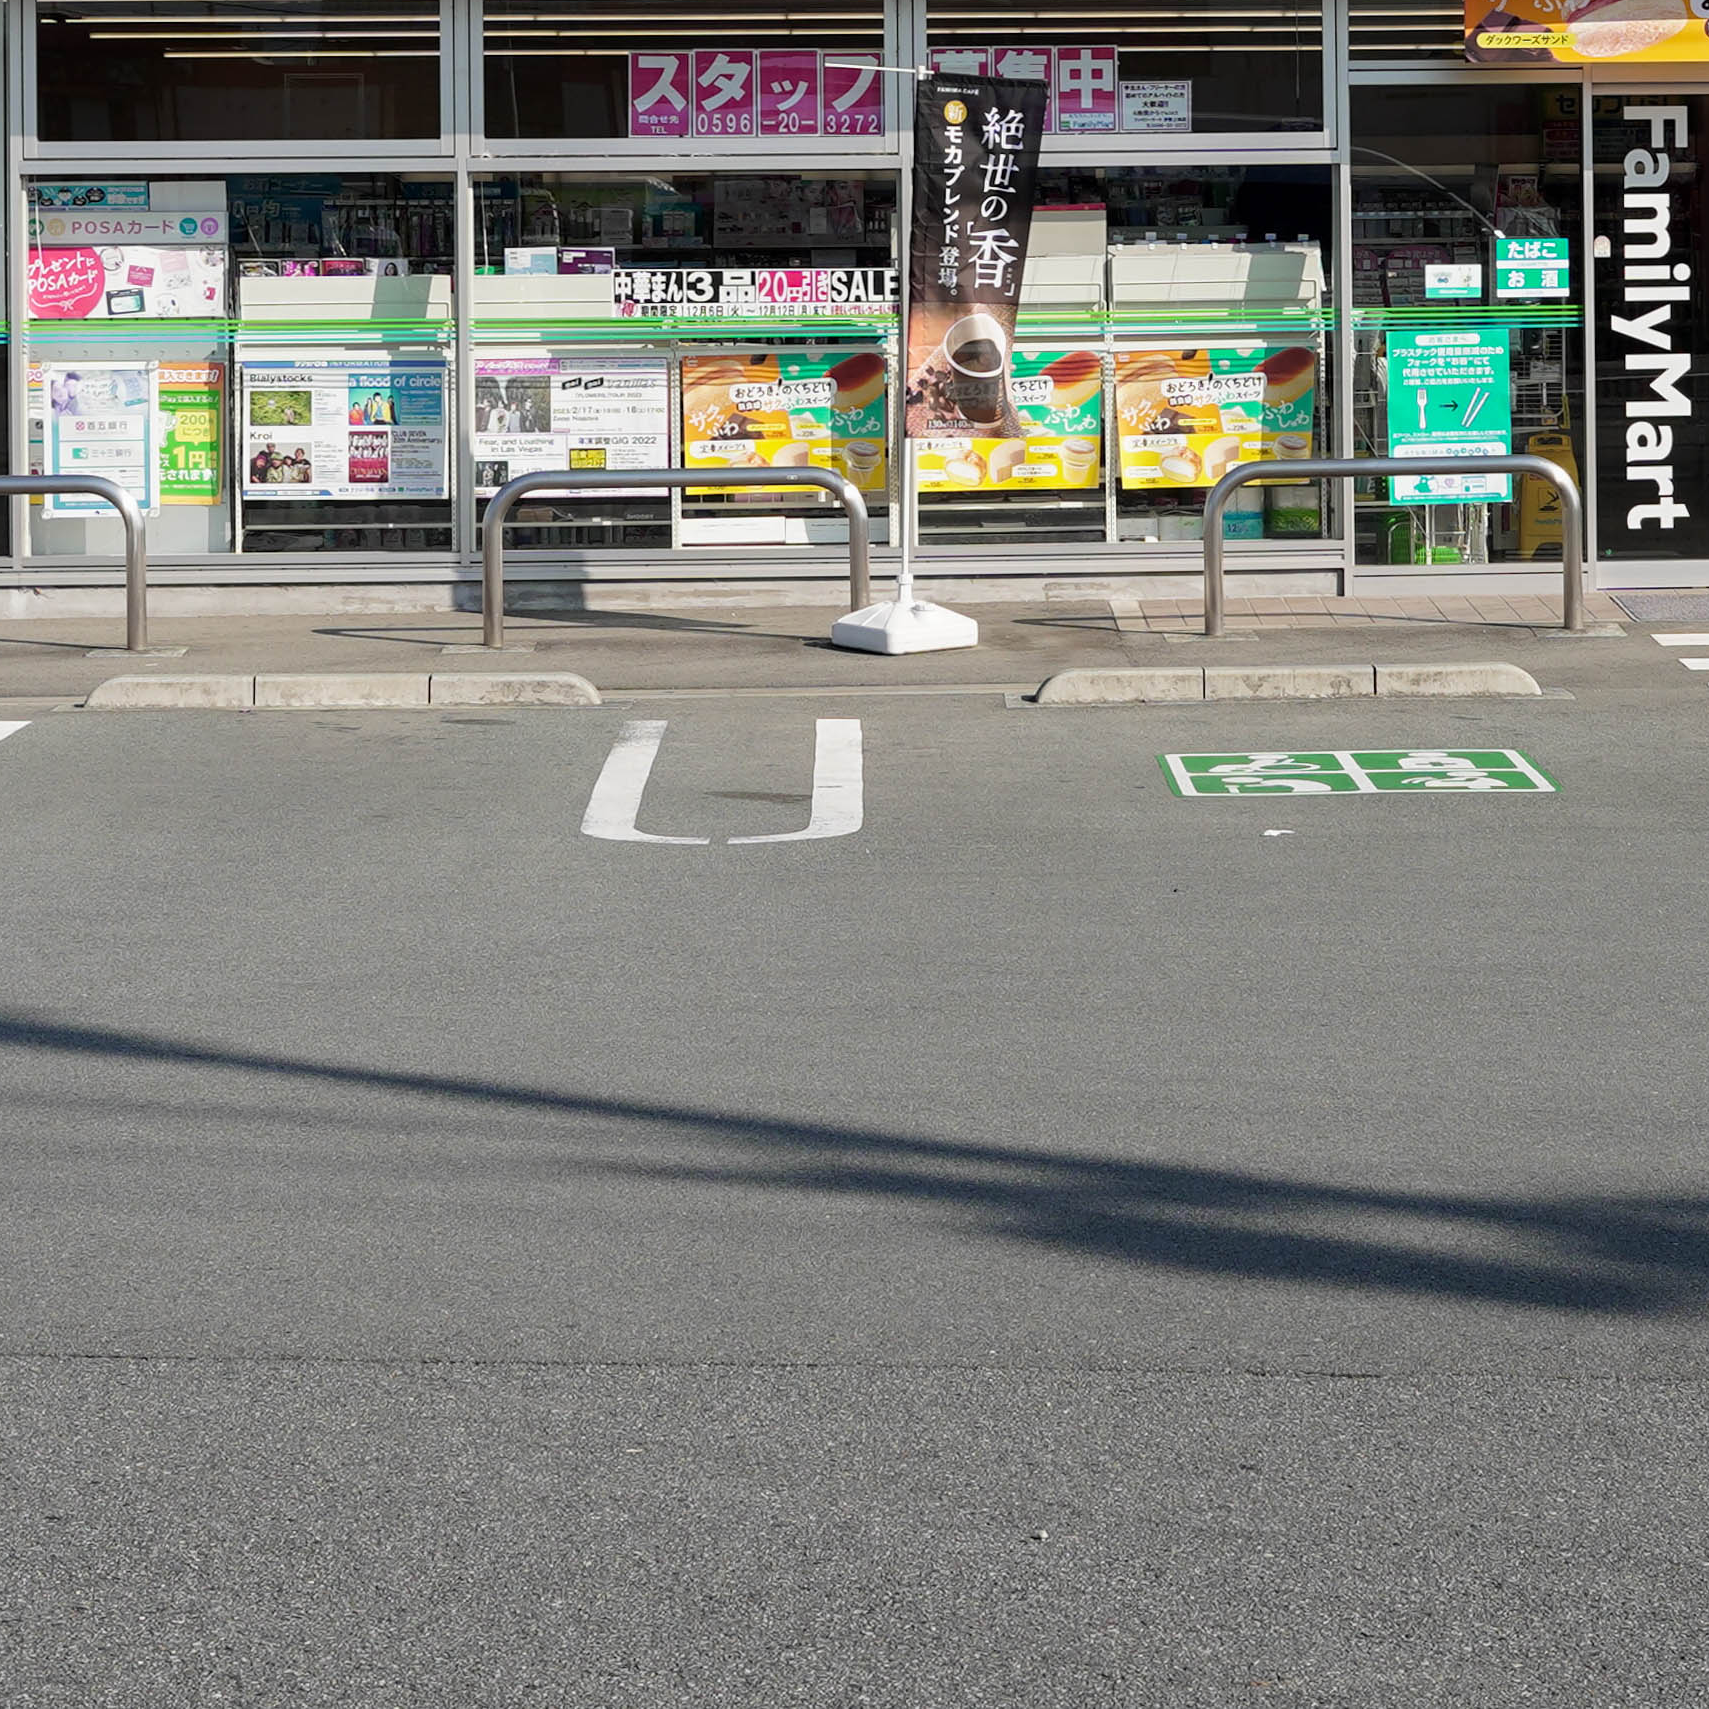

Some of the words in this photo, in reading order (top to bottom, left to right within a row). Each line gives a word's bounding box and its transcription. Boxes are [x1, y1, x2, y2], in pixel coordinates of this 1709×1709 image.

[1485, 33, 1570, 47] ダックワーズサンド
[651, 126, 667, 134] TEL
[697, 114, 750, 133] 0596
[826, 114, 878, 133] 3272
[72, 220, 175, 235] POSAカード
[1507, 241, 1558, 259] たばこ
[1508, 270, 1559, 287] お酒
[614, 271, 683, 303] 中華まん
[688, 271, 756, 303] 3品
[759, 271, 828, 303] 20円引き
[832, 271, 899, 302] SALE
[1610, 105, 1692, 530] FamilyMart
[360, 375, 390, 387] flood
[393, 375, 406, 387] of
[409, 375, 442, 387] circle
[250, 431, 273, 440] Kroi
